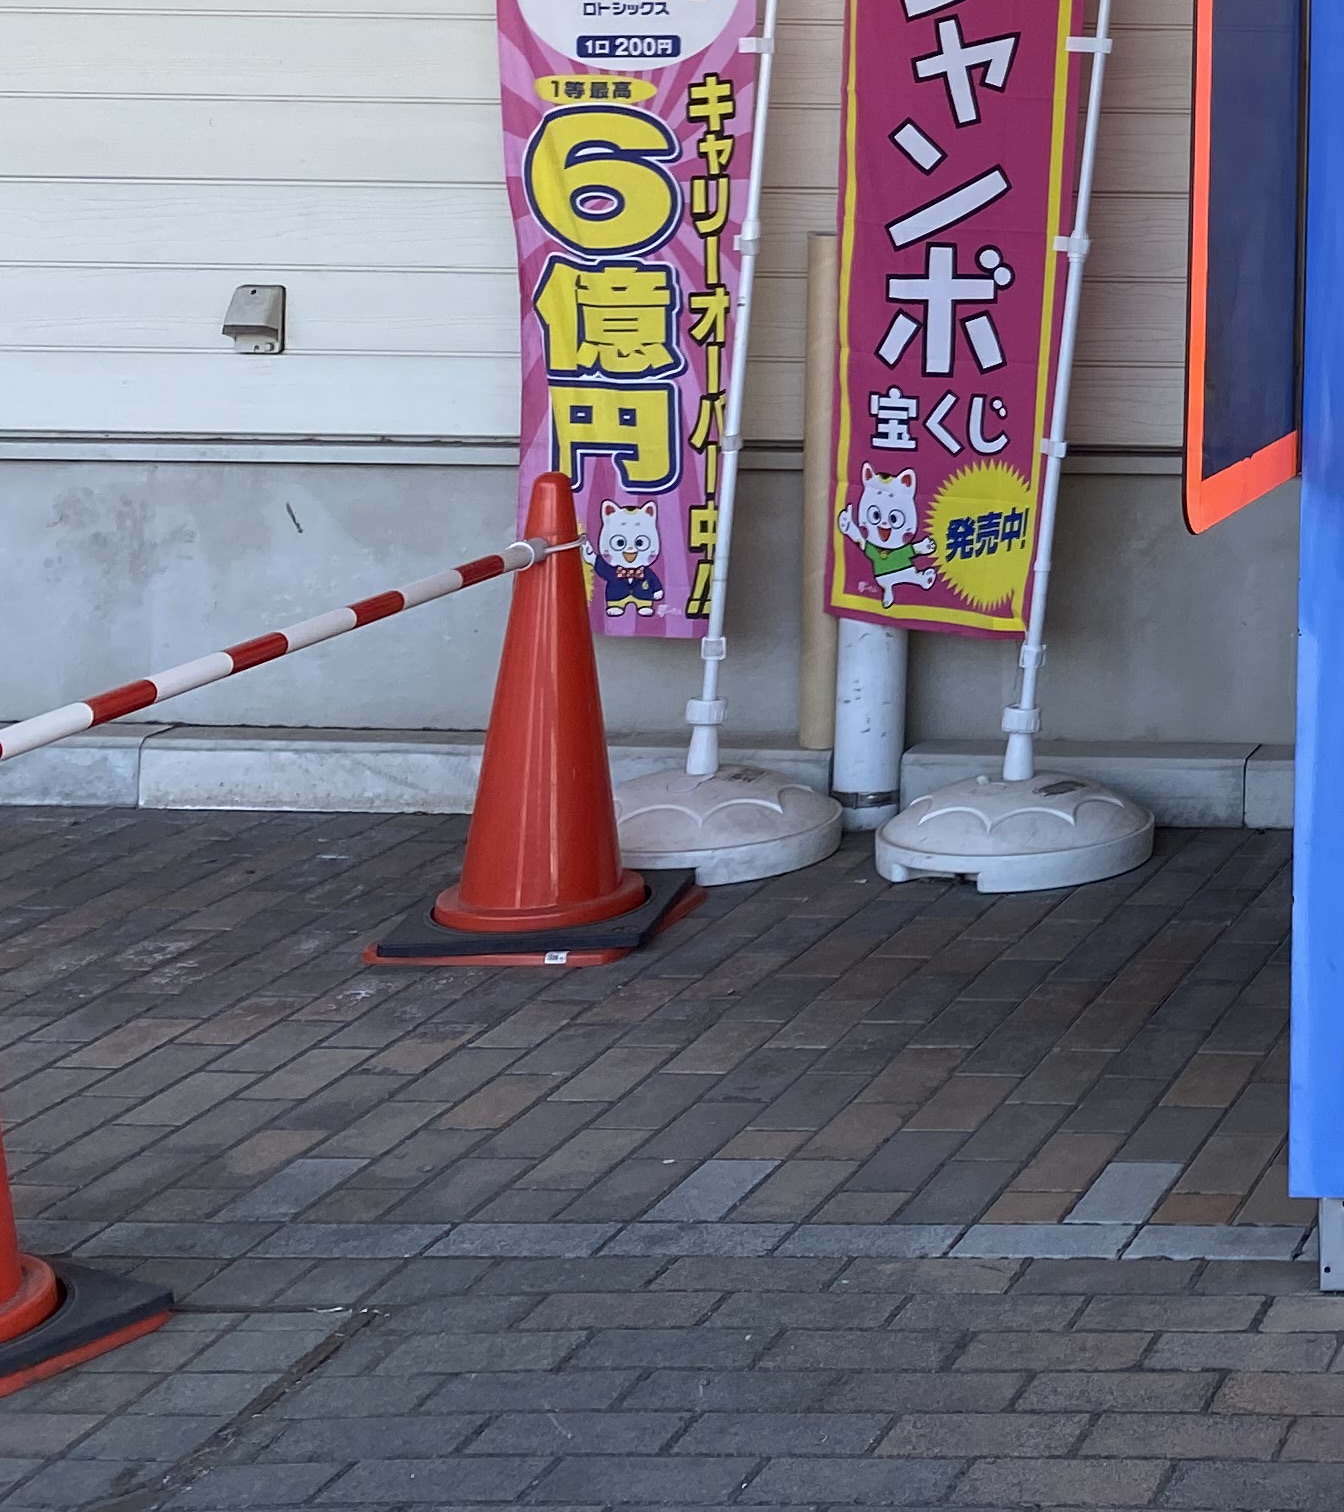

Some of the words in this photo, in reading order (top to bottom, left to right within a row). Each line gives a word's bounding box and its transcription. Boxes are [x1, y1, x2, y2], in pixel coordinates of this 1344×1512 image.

[582, 1, 670, 17] ロトシックス
[585, 39, 609, 56] 1口
[615, 38, 674, 57] 200円
[550, 79, 633, 100] 1等最高
[523, 102, 685, 492] 6億円
[867, 385, 1011, 456] 宝くじ
[945, 507, 1029, 562] 発売中!
